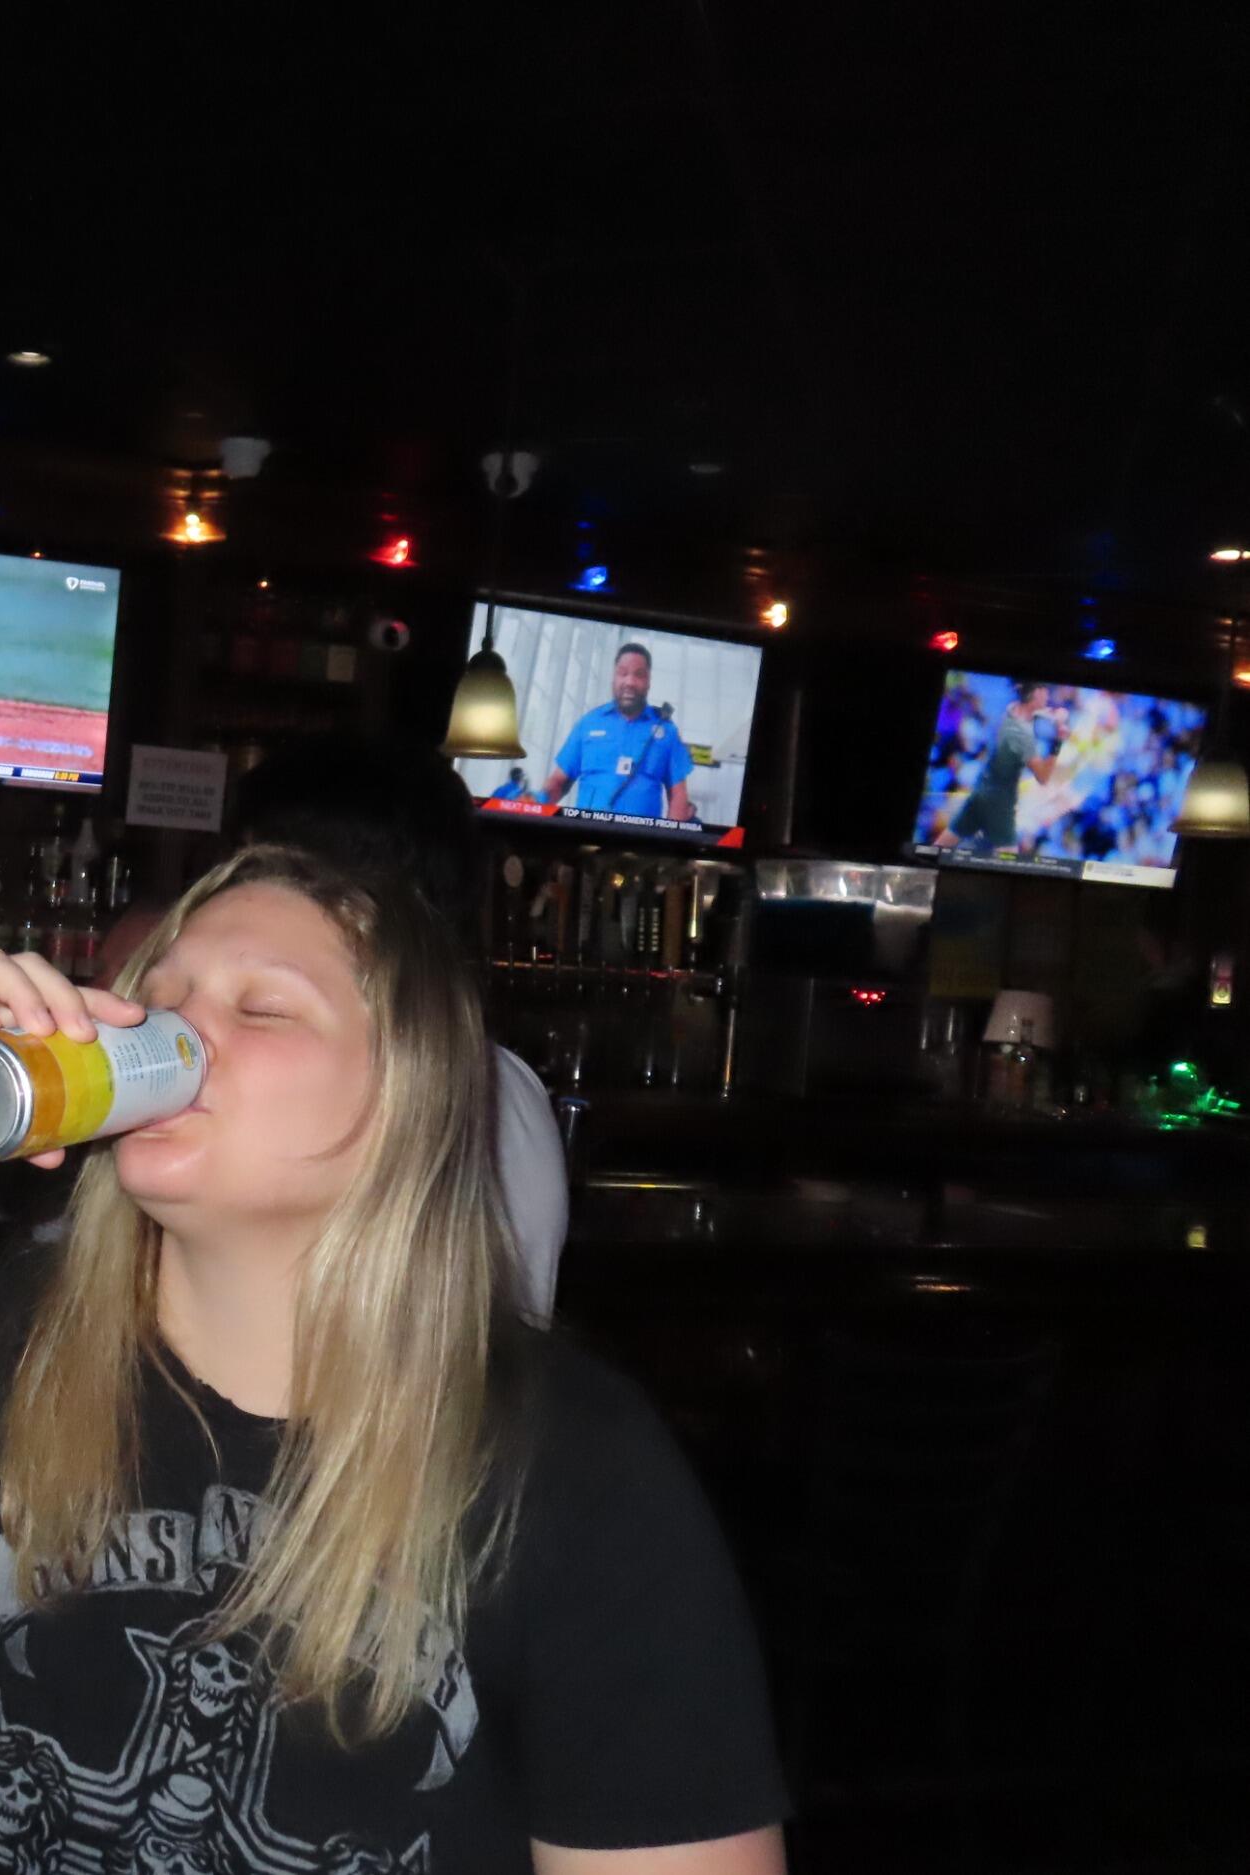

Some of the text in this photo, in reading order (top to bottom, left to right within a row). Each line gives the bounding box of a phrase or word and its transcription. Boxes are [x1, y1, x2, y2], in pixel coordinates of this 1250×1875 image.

[563, 807, 579, 817] TOP
[593, 812, 614, 822] HALF
[615, 814, 654, 826] MOMENTS
[655, 818, 678, 829] FROM
